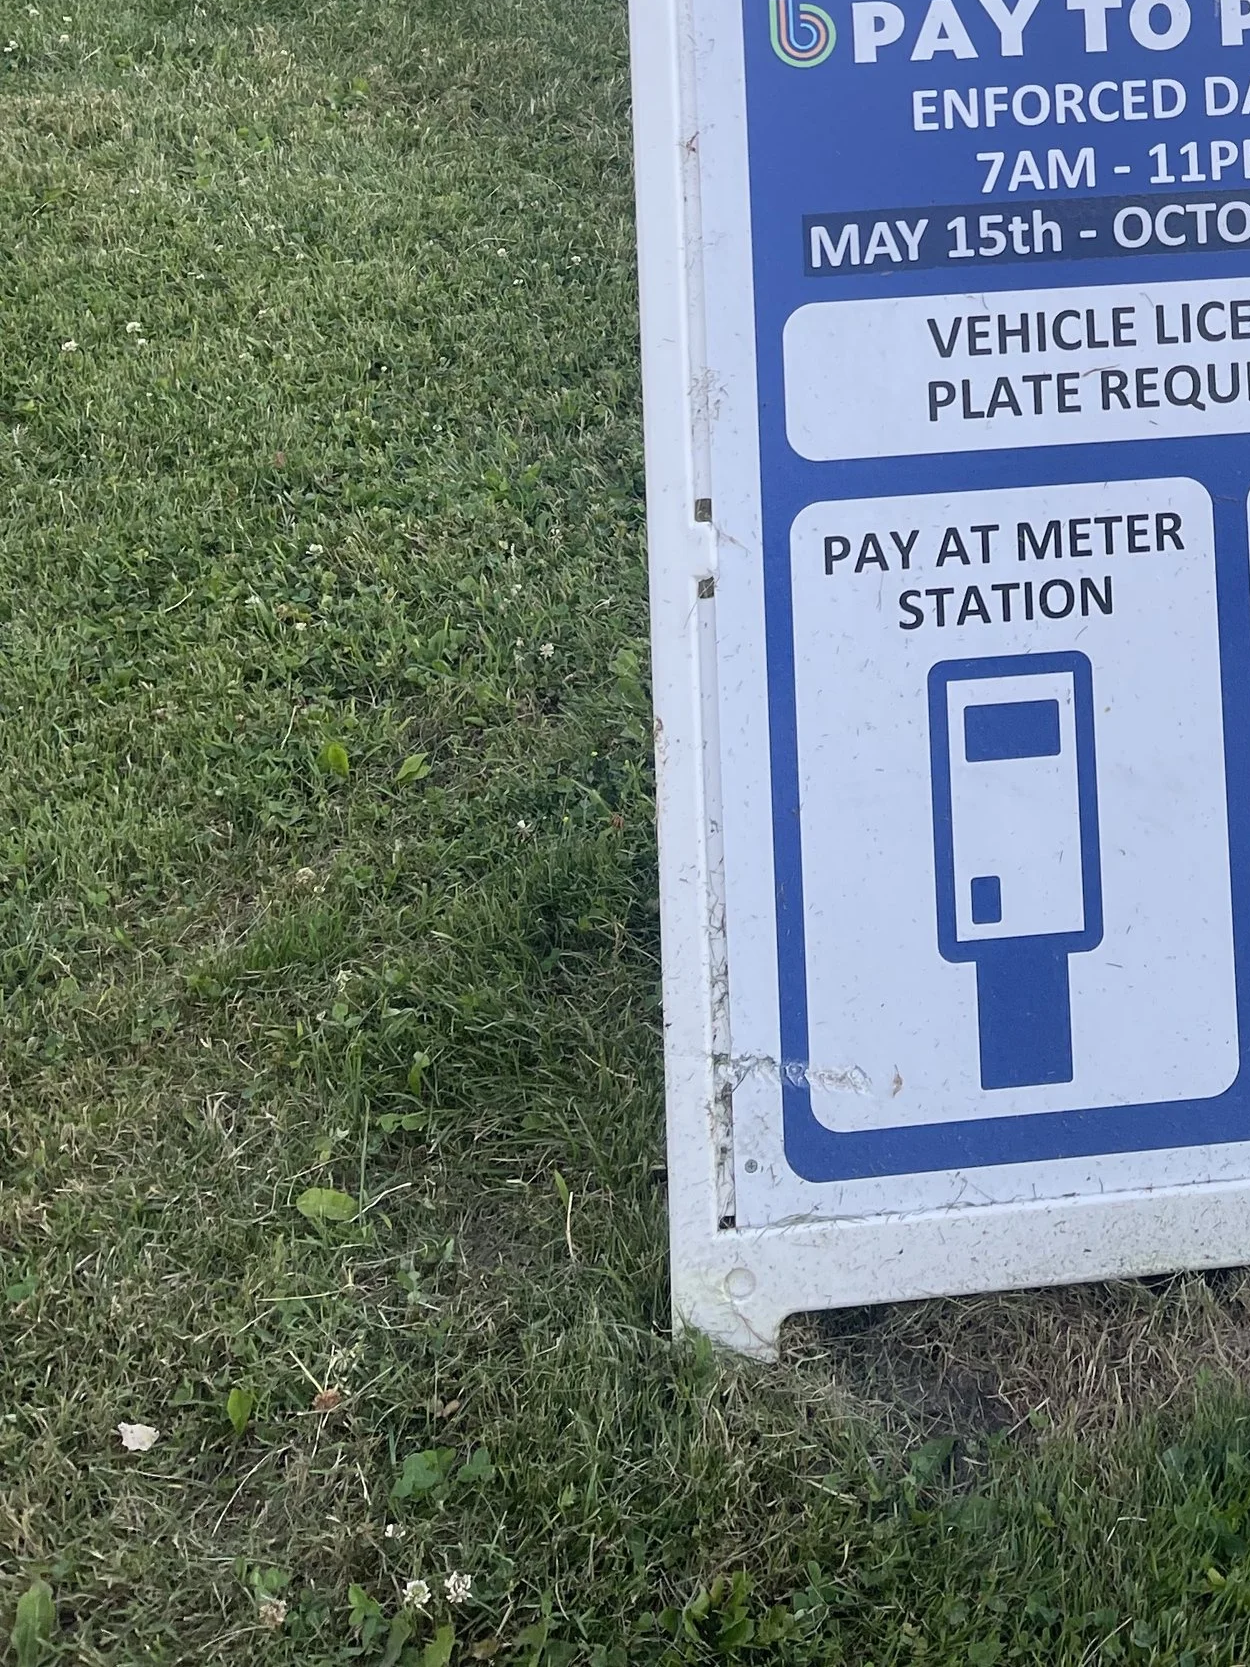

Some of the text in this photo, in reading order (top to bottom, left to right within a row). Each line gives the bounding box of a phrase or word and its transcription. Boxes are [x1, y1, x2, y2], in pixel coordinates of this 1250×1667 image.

[912, 76, 1186, 132] ENFORCED
[976, 146, 1096, 194] 7AM
[810, 218, 928, 268] MAY
[946, 208, 1063, 259] 15th
[927, 306, 1137, 359] VEHICLE
[928, 370, 1081, 422] PLATE
[823, 511, 1185, 575] PAY AT METER
[899, 575, 1113, 630] STATION
